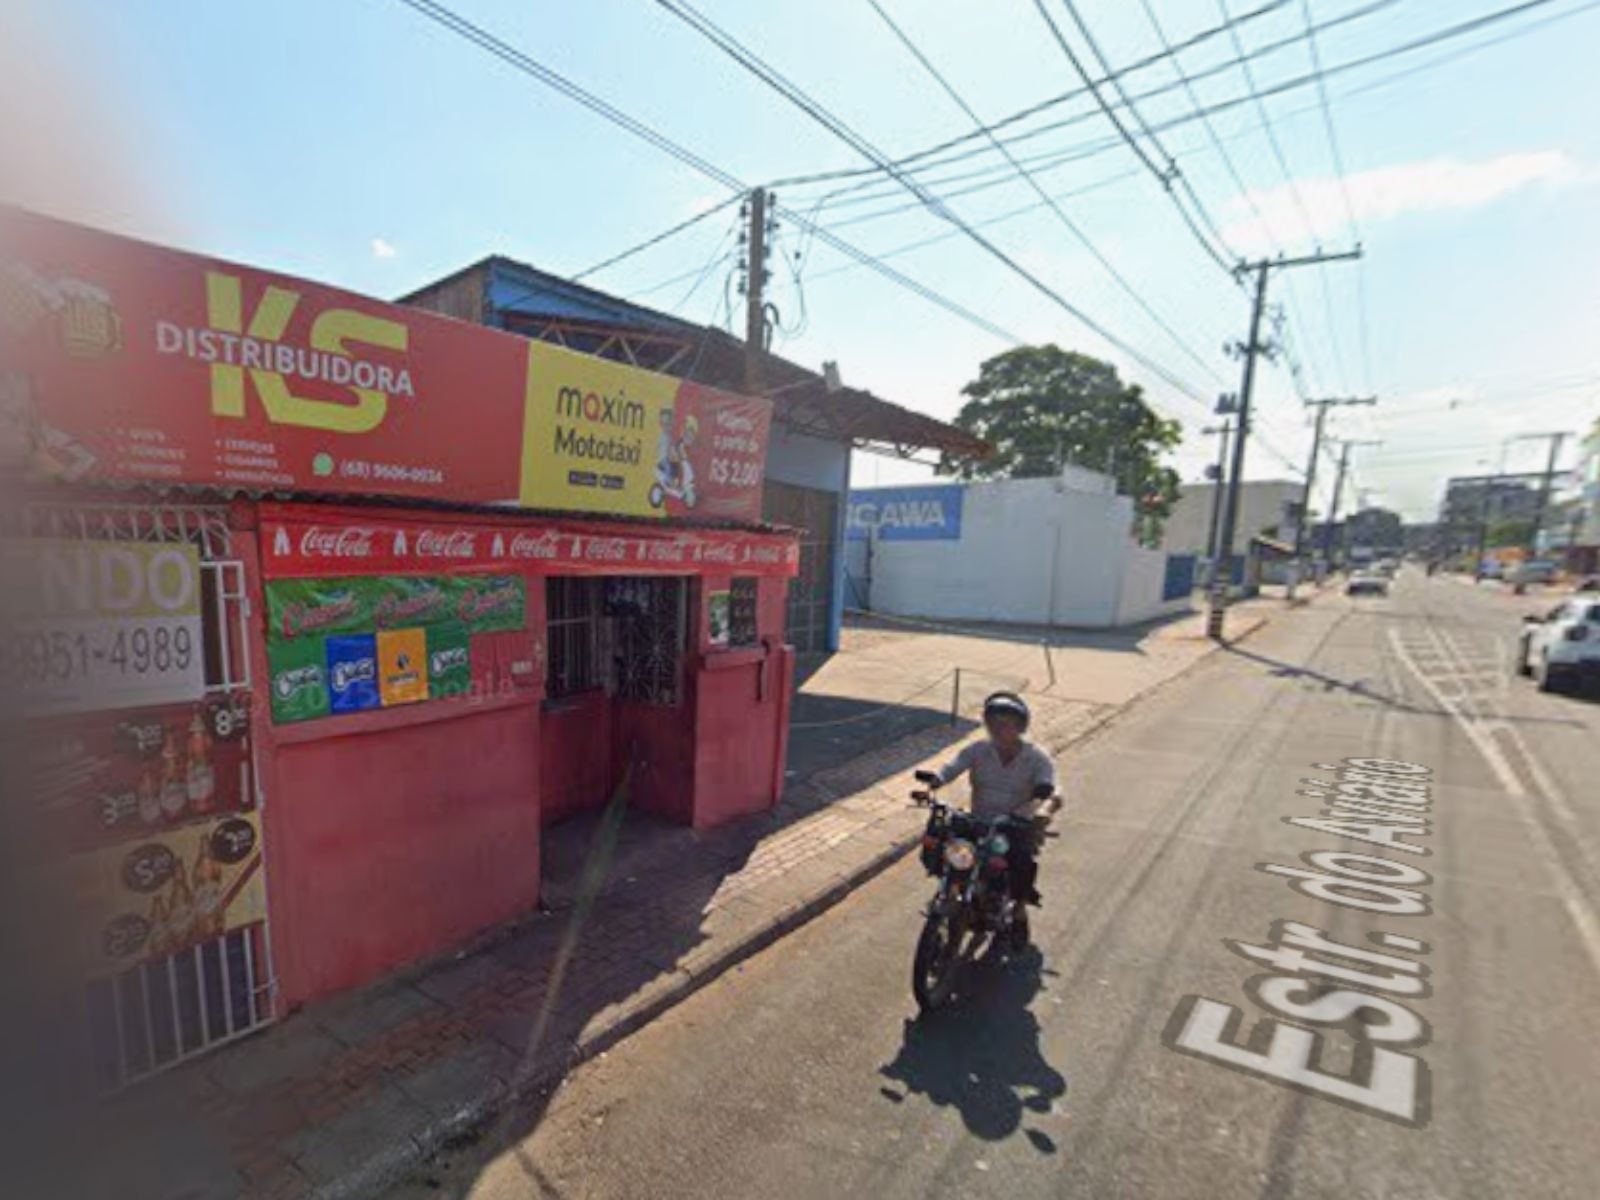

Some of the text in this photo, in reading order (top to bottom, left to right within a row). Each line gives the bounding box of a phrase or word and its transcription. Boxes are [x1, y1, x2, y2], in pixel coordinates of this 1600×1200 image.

[155, 321, 415, 396] DISTRIBUIDORA
[205, 271, 408, 434] KS
[556, 386, 645, 430] maxim
[553, 424, 642, 467] Mototáxi
[38, 547, 193, 612] NDO
[12, 626, 193, 682] 951-4989
